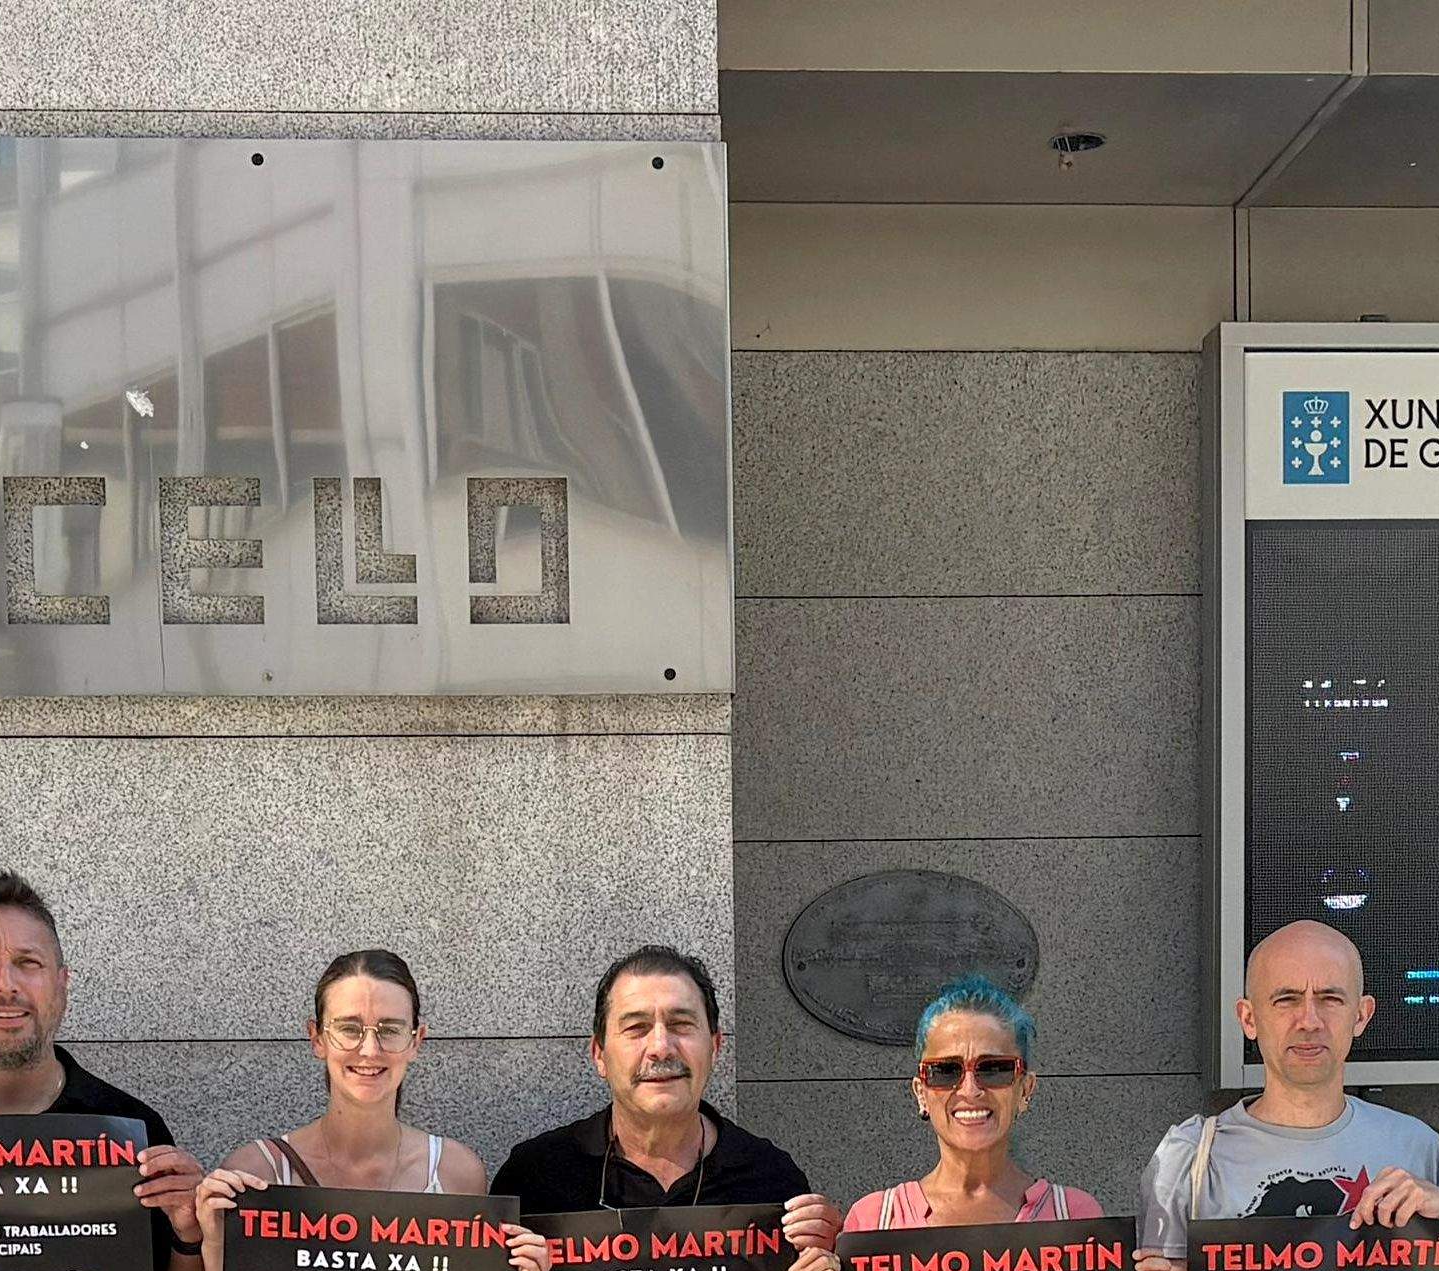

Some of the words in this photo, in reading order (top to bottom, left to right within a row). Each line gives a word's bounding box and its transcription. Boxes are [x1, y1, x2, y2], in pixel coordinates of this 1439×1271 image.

[1365, 438, 1408, 468] DE
[14, 1176, 50, 1195] XA
[240, 1208, 360, 1243] TELMO
[370, 1215, 511, 1249] MARTÍN
[547, 1232, 641, 1265] ELMO
[650, 1224, 781, 1261] MARTÍN
[296, 1249, 377, 1271] BASTA
